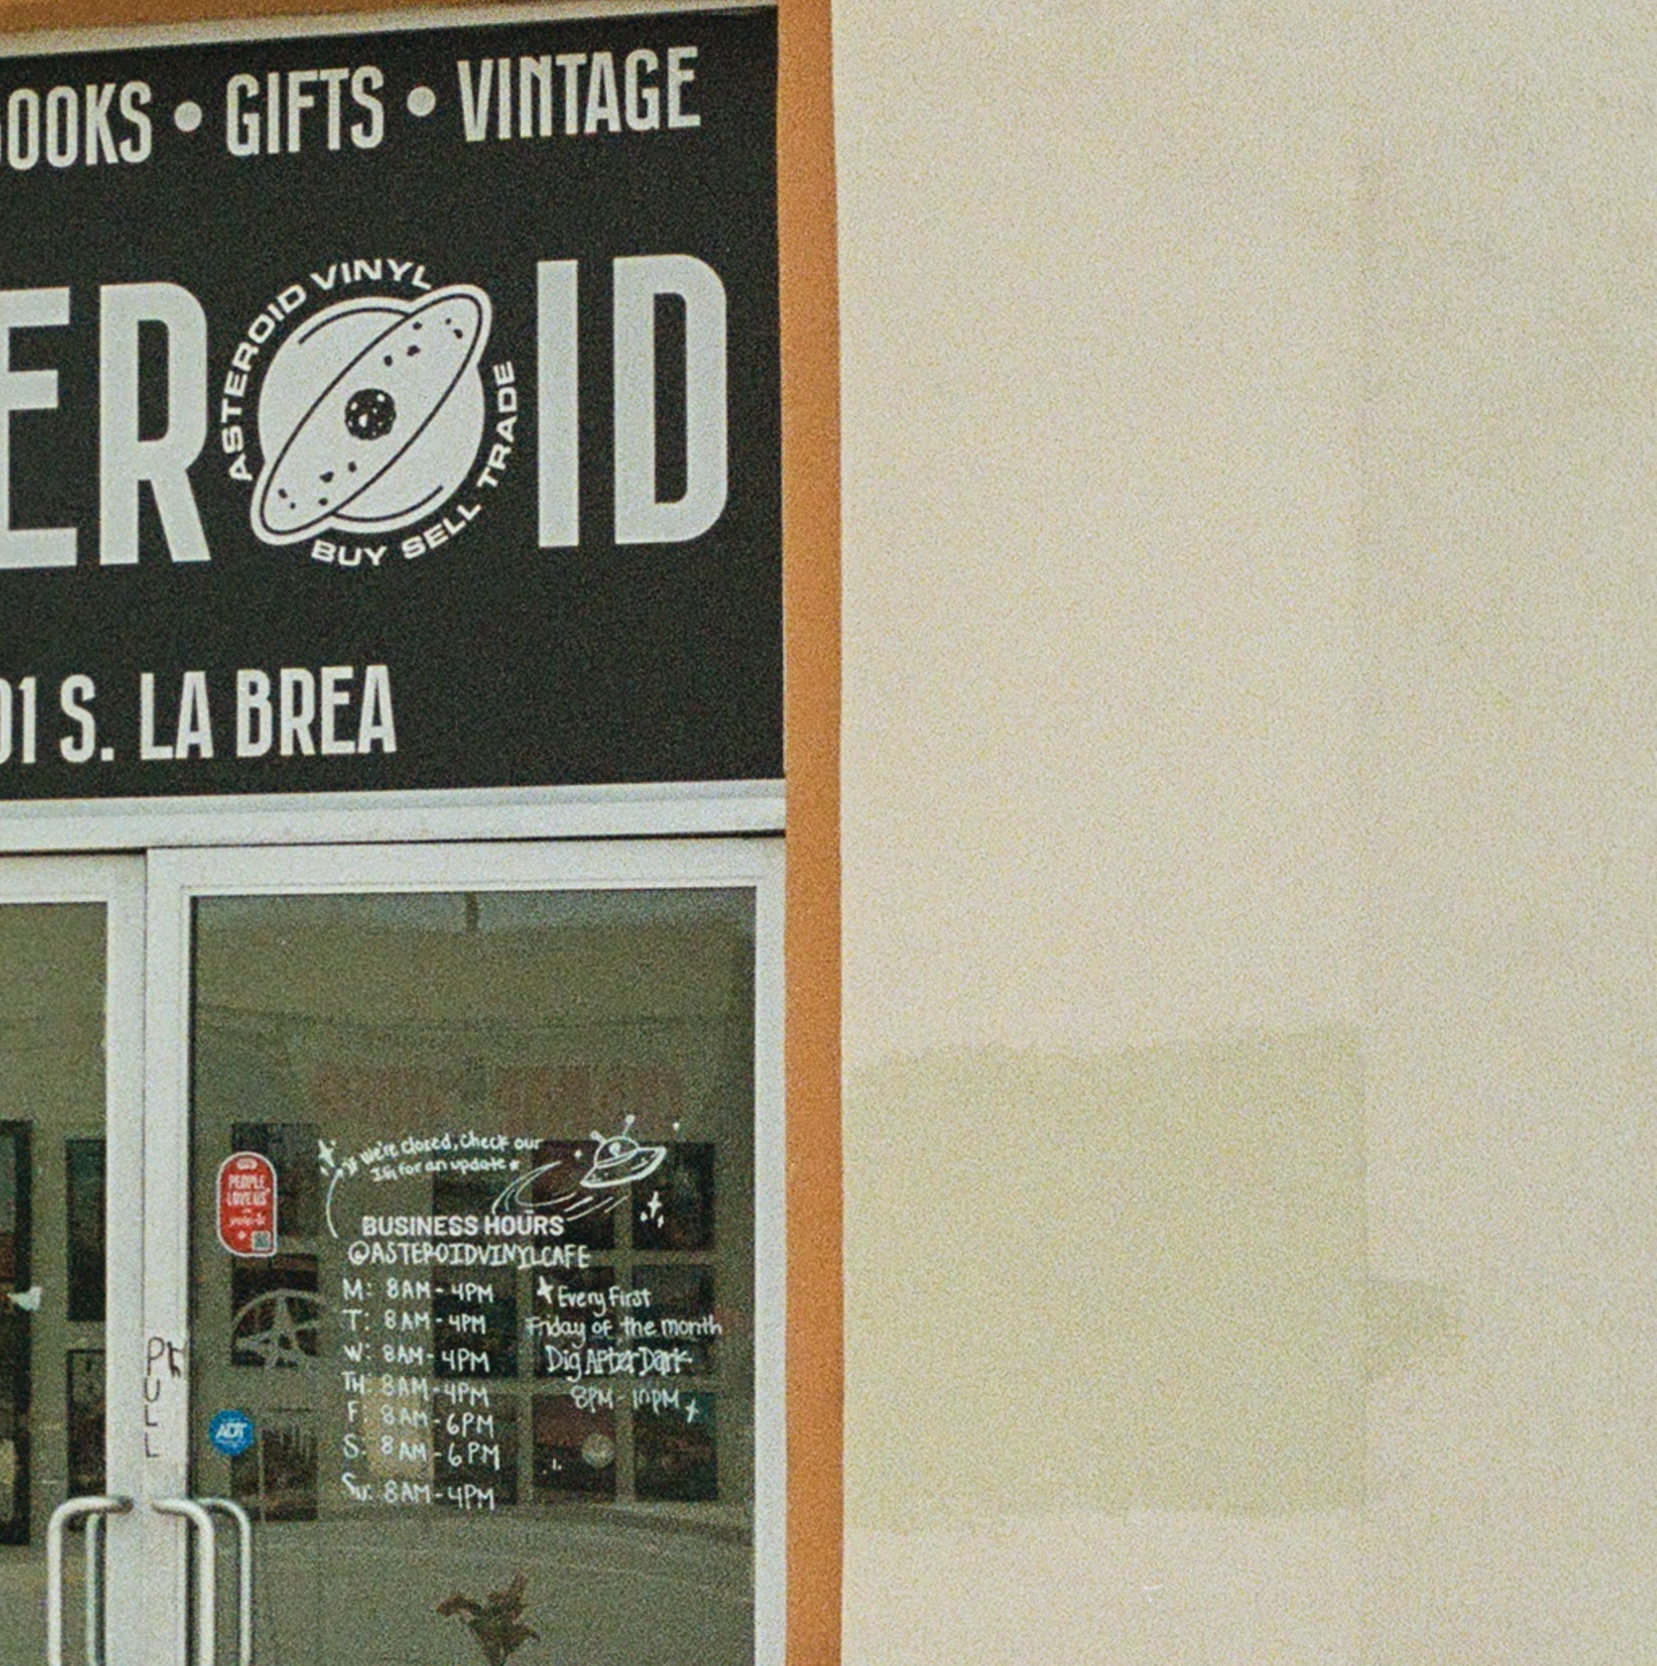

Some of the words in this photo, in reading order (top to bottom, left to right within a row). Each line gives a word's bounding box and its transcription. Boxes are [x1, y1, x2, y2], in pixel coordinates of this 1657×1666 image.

[226, 66, 385, 157] GIFTS
[458, 45, 701, 142] VINTAGE
[221, 284, 307, 482] ASTEROID
[310, 258, 431, 292] VINYL
[311, 539, 387, 567] BUY
[401, 503, 482, 560] SELL
[477, 360, 518, 488] TRADE
[59, 672, 114, 763] S.
[141, 669, 214, 760] LA
[236, 664, 398, 758] BREA
[514, 1136, 544, 1150] our
[425, 1159, 447, 1171] an
[451, 1157, 507, 1174] update
[361, 1215, 479, 1237] BUSINESS
[484, 1214, 565, 1236] HOURS
[557, 1286, 607, 1317] Every
[525, 1314, 587, 1349] Friday
[620, 1315, 657, 1337] the
[661, 1314, 722, 1336] month
[545, 1345, 582, 1382] Dig
[144, 1336, 166, 1458] PULL
[215, 1422, 248, 1439] ADT
